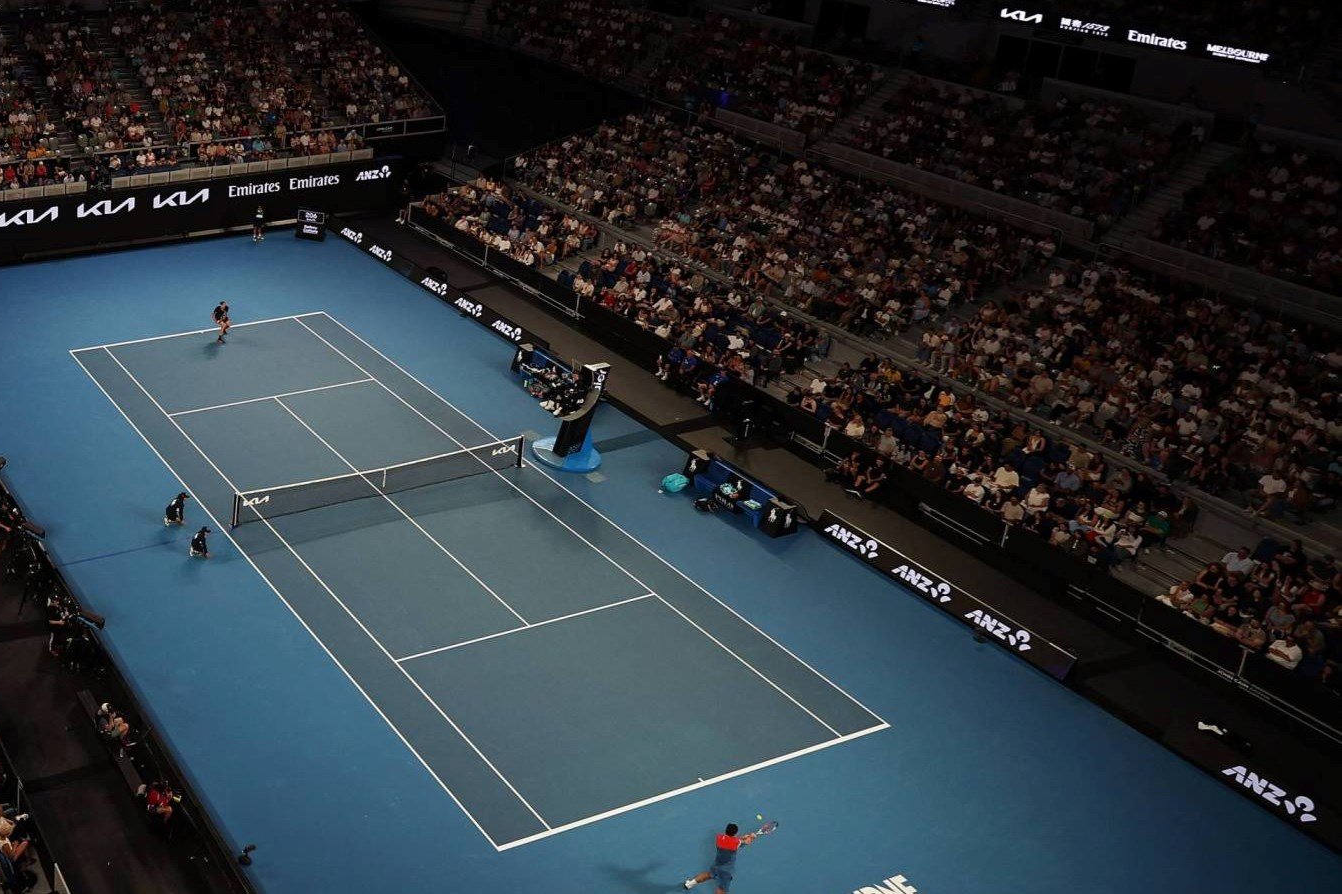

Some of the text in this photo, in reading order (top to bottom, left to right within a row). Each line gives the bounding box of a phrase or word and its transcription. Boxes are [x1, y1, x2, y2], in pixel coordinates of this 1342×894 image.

[1127, 29, 1188, 51] Emirates
[1206, 43, 1270, 62] MELBOURNE
[289, 174, 340, 191] Emirates
[355, 170, 380, 182] ANZ
[228, 181, 281, 198] Emirates
[340, 227, 357, 241] ANZ
[369, 245, 385, 258] ANZ
[420, 276, 438, 292] ANZ
[454, 297, 474, 313] ANZ
[491, 319, 512, 337] ANZ
[824, 523, 862, 550] ANZ
[891, 564, 933, 593] ANZ
[964, 609, 1012, 640] ANZ
[1221, 765, 1287, 806] ANZ
